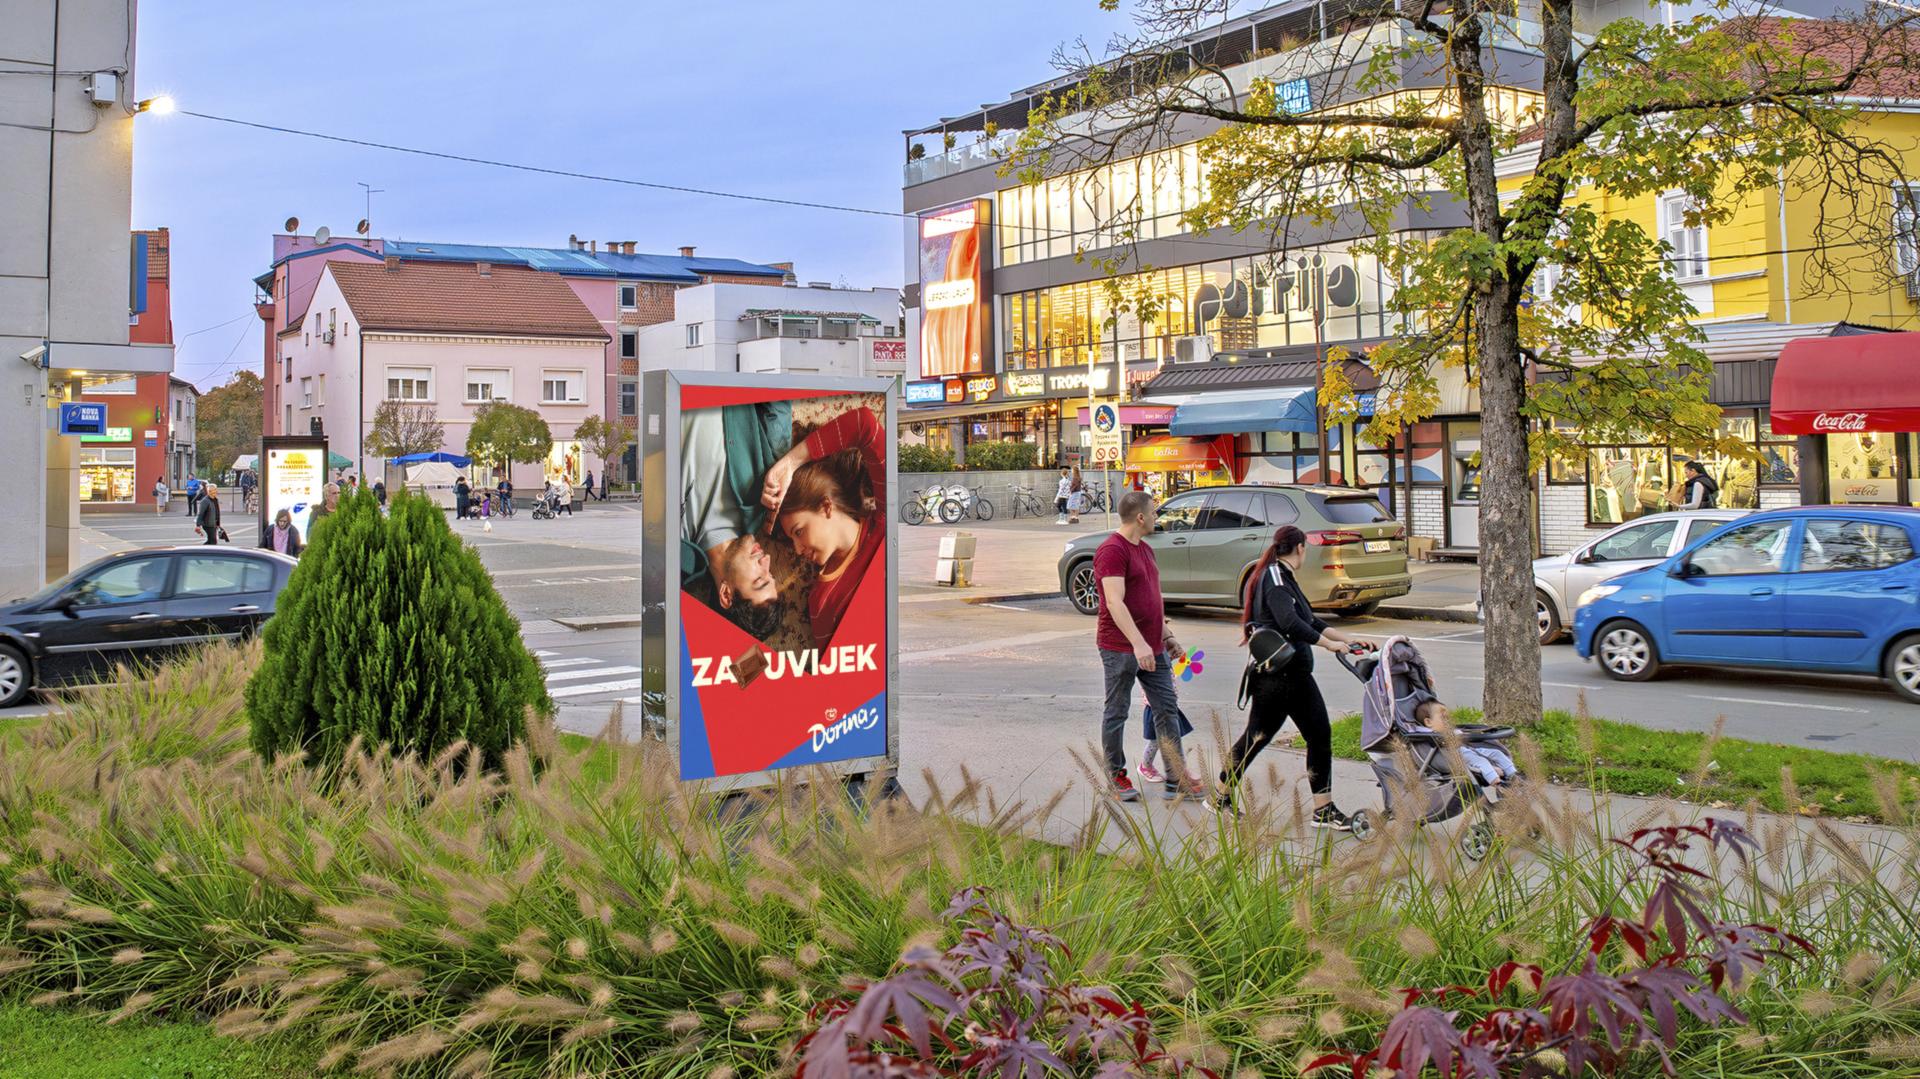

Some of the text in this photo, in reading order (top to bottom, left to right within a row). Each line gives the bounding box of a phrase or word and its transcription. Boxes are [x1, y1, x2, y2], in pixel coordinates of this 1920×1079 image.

[1274, 79, 1308, 100] NOVA
[1049, 373, 1094, 390] TROPI
[1812, 412, 1868, 430] Coca-Cola
[807, 707, 869, 753] Dorina
